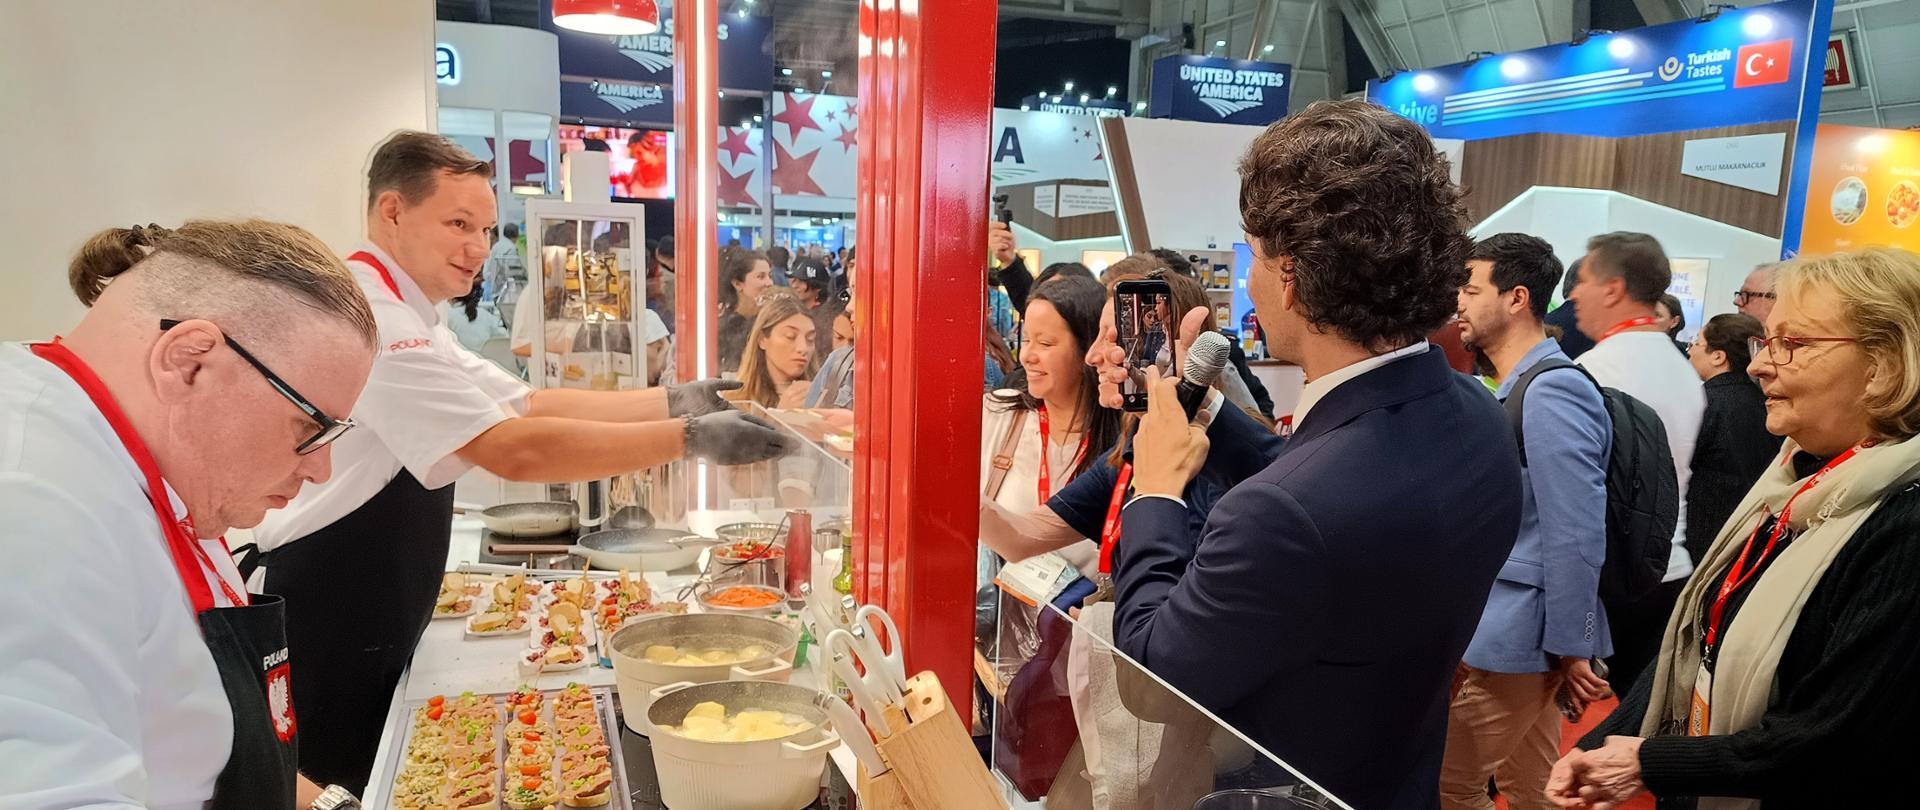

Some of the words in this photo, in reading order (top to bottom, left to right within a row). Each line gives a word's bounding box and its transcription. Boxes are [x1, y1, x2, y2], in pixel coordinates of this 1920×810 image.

[619, 35, 672, 52] AMER
[1687, 47, 1731, 65] Turkish
[1180, 64, 1234, 84] UNITED
[1235, 70, 1284, 87] STATES
[1686, 64, 1722, 79] Tastes
[597, 83, 663, 100] AMERICA
[1200, 83, 1264, 101] AMERICA
[1040, 103, 1084, 116] UNITED
[1695, 163, 1718, 172] MUTLU
